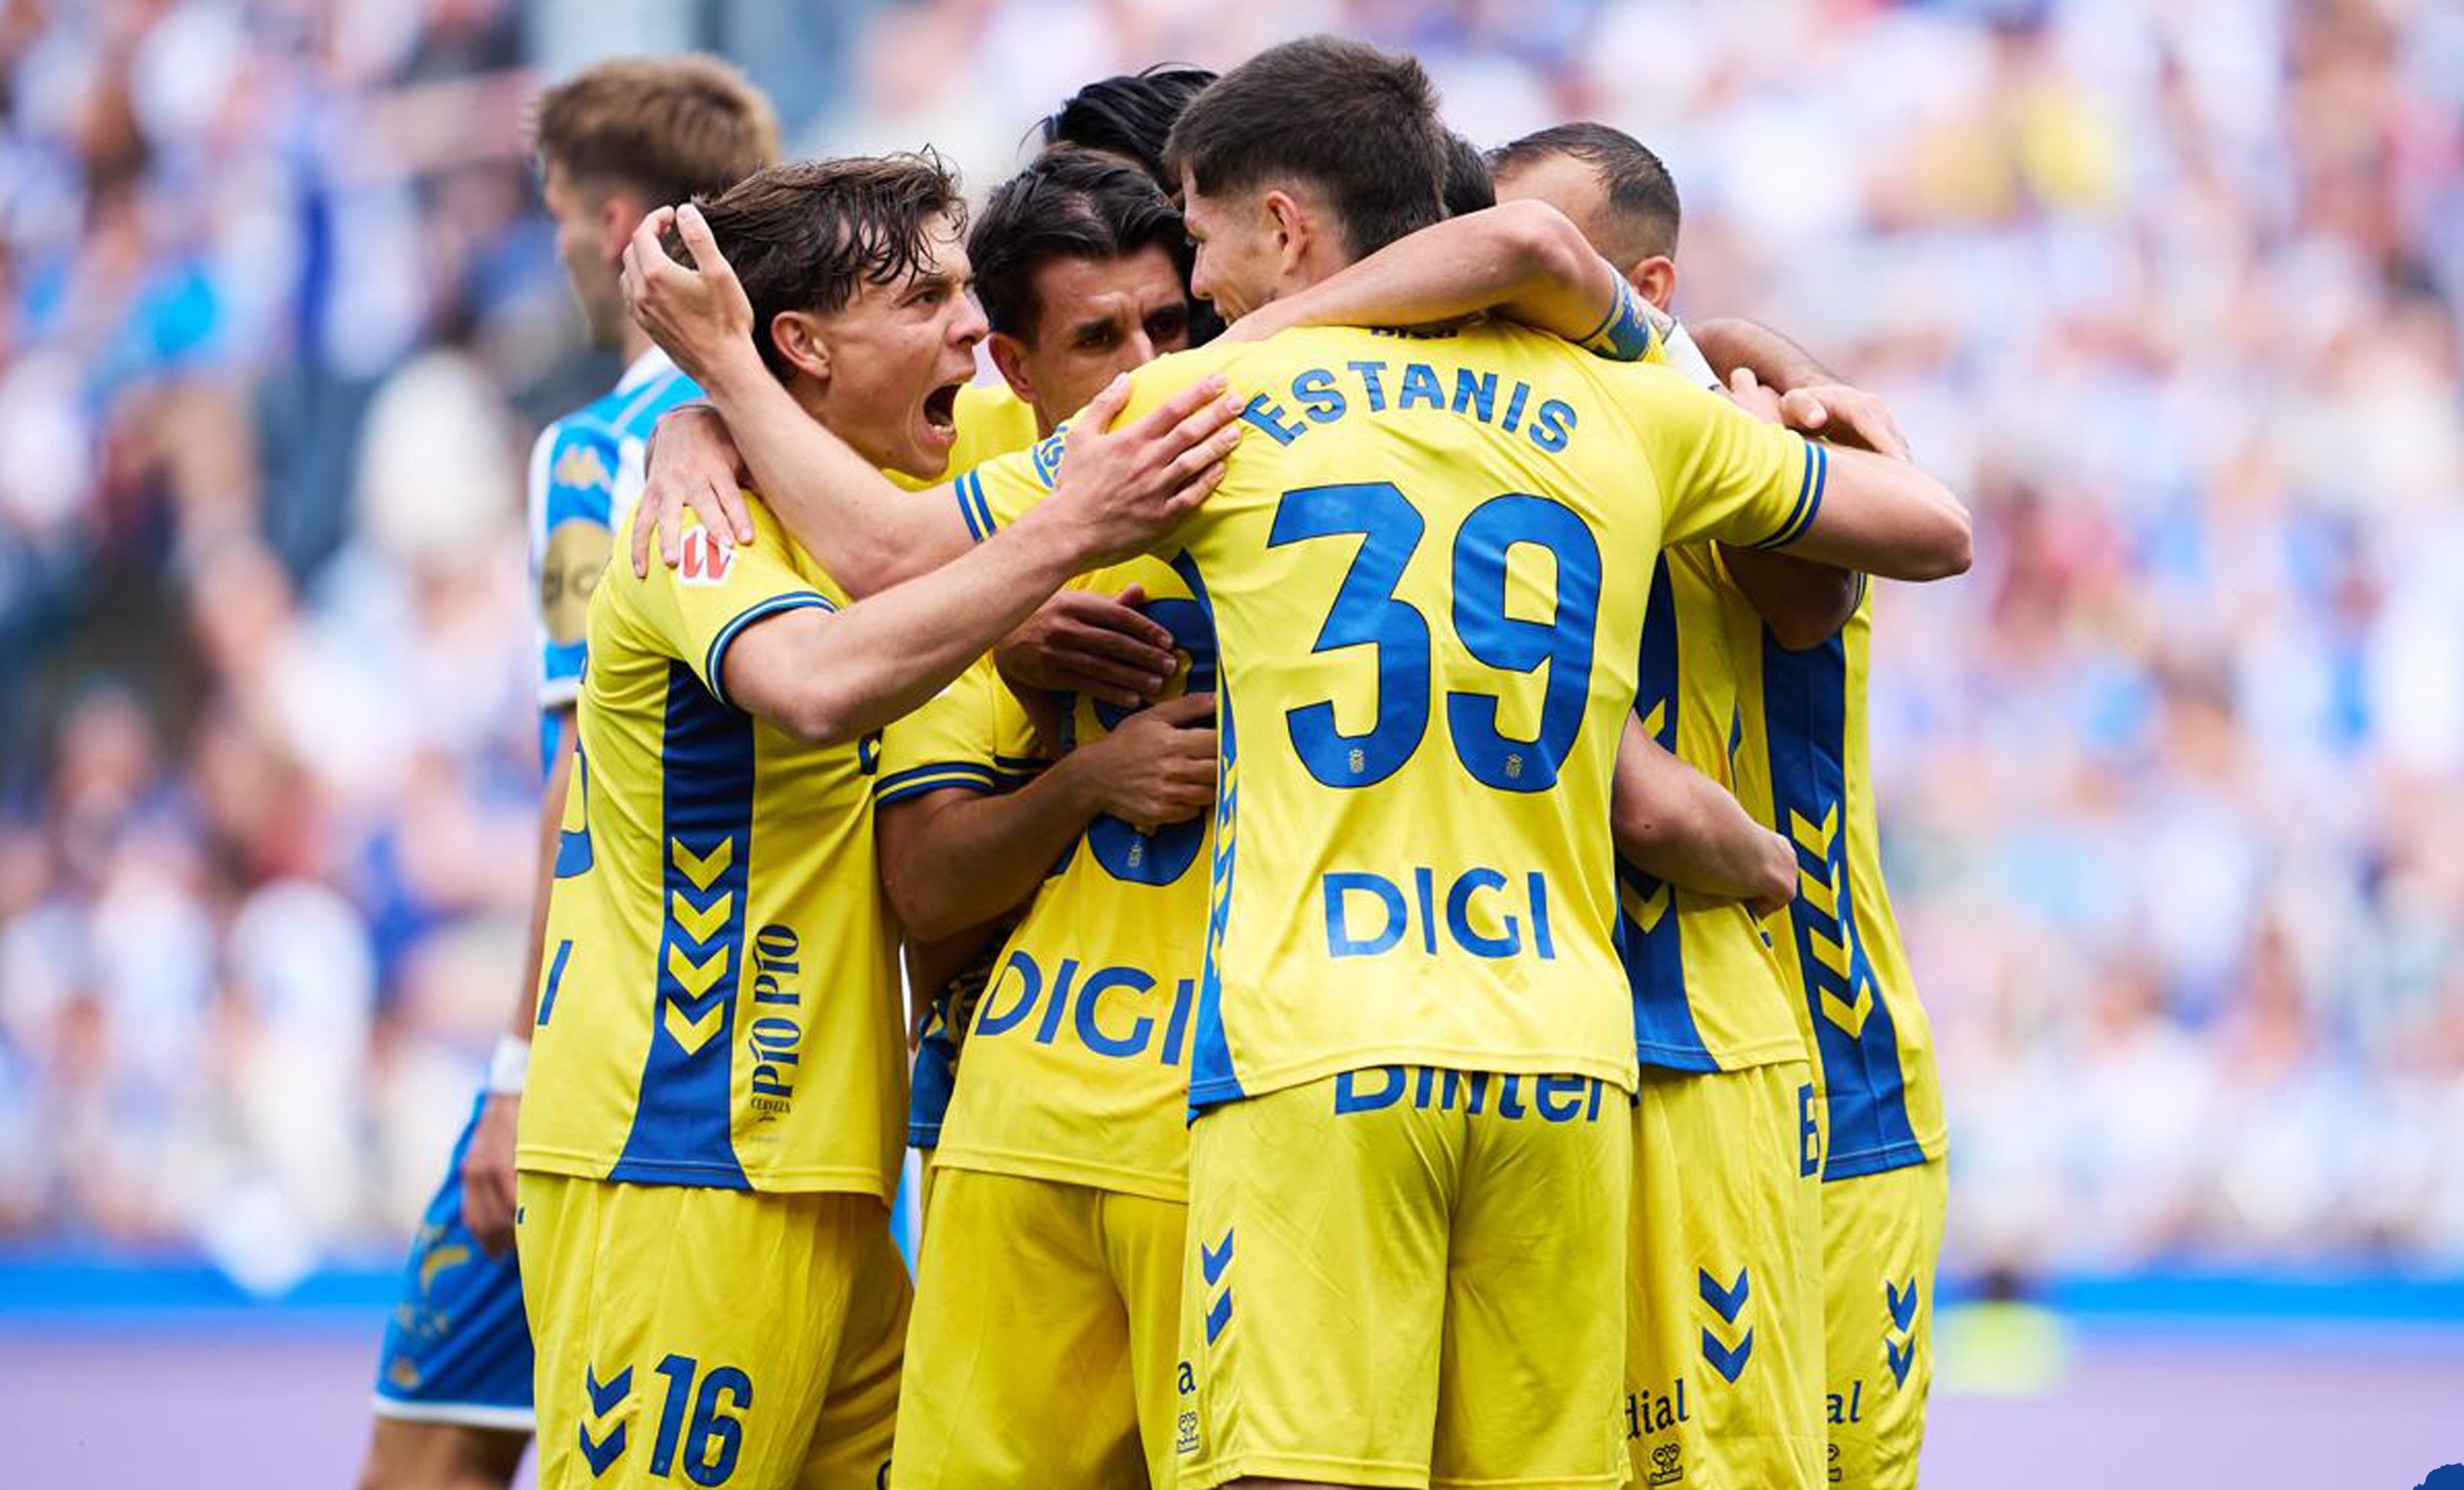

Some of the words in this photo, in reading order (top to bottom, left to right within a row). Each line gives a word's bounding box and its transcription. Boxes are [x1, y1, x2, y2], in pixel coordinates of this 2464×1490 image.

[1241, 360, 1578, 454] ESTANIS
[1268, 482, 1602, 793] 39
[1323, 867, 1556, 960] DIGI
[974, 949, 1196, 1066] DIGI
[649, 1353, 753, 1488] 16
